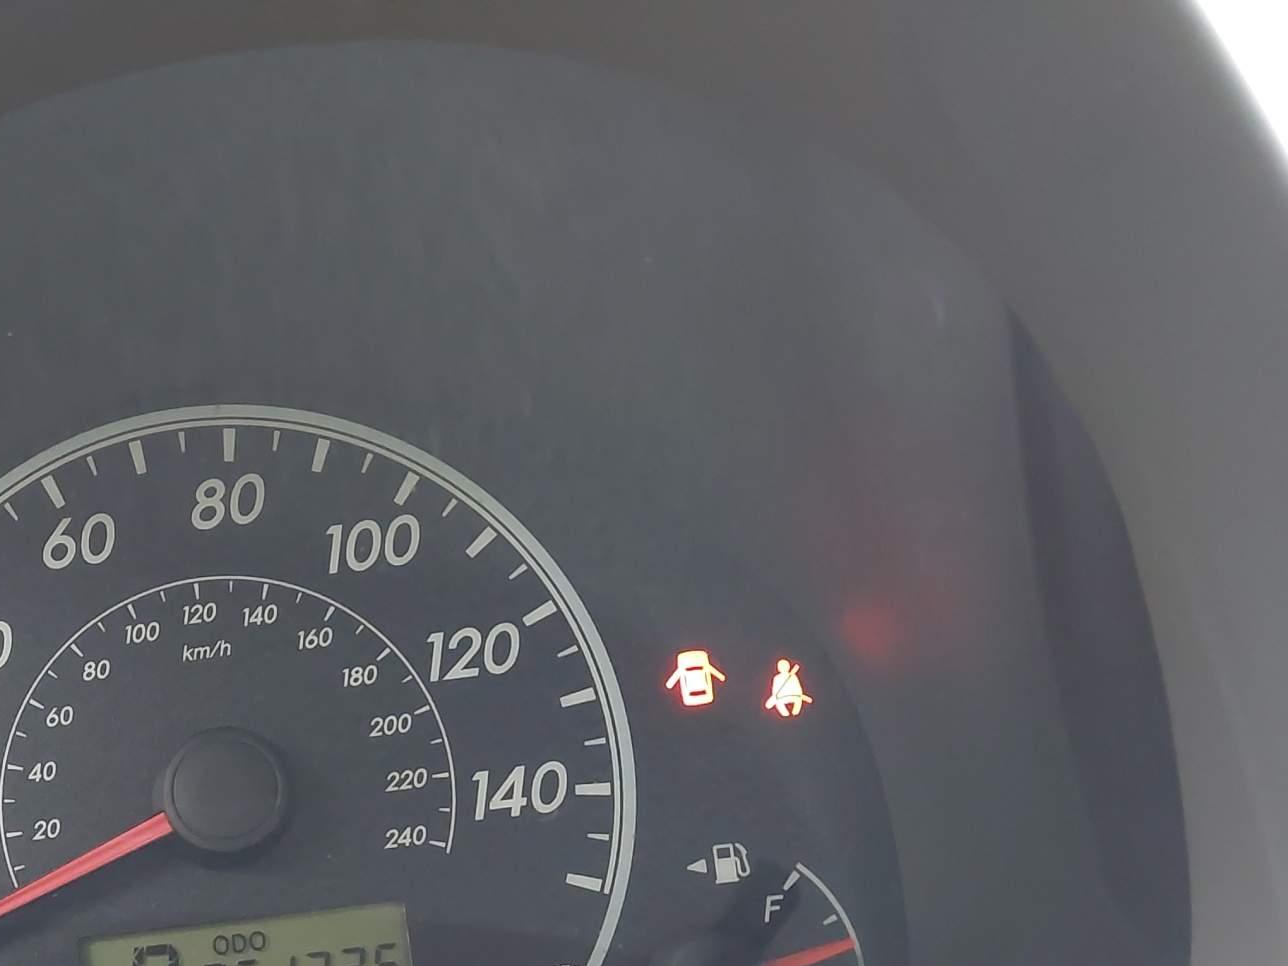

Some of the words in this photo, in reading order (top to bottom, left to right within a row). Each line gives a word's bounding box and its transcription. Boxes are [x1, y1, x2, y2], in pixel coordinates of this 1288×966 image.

[191, 473, 265, 530] 80
[42, 512, 115, 569] 60
[325, 514, 421, 574] 100
[182, 602, 217, 625] 120
[242, 604, 278, 627] 140
[124, 621, 160, 645] 100
[297, 627, 333, 650] 160
[182, 639, 232, 662] km/h
[426, 622, 520, 682] 120
[82, 659, 110, 681] 80
[342, 664, 378, 687] 180
[45, 706, 74, 728] 60
[369, 713, 412, 737] 200
[28, 761, 57, 782] 40
[385, 768, 428, 792] 220
[471, 760, 568, 821] 140
[32, 819, 60, 840] 20
[384, 826, 427, 850] 240
[764, 895, 783, 923] F
[213, 930, 267, 955] ODO
